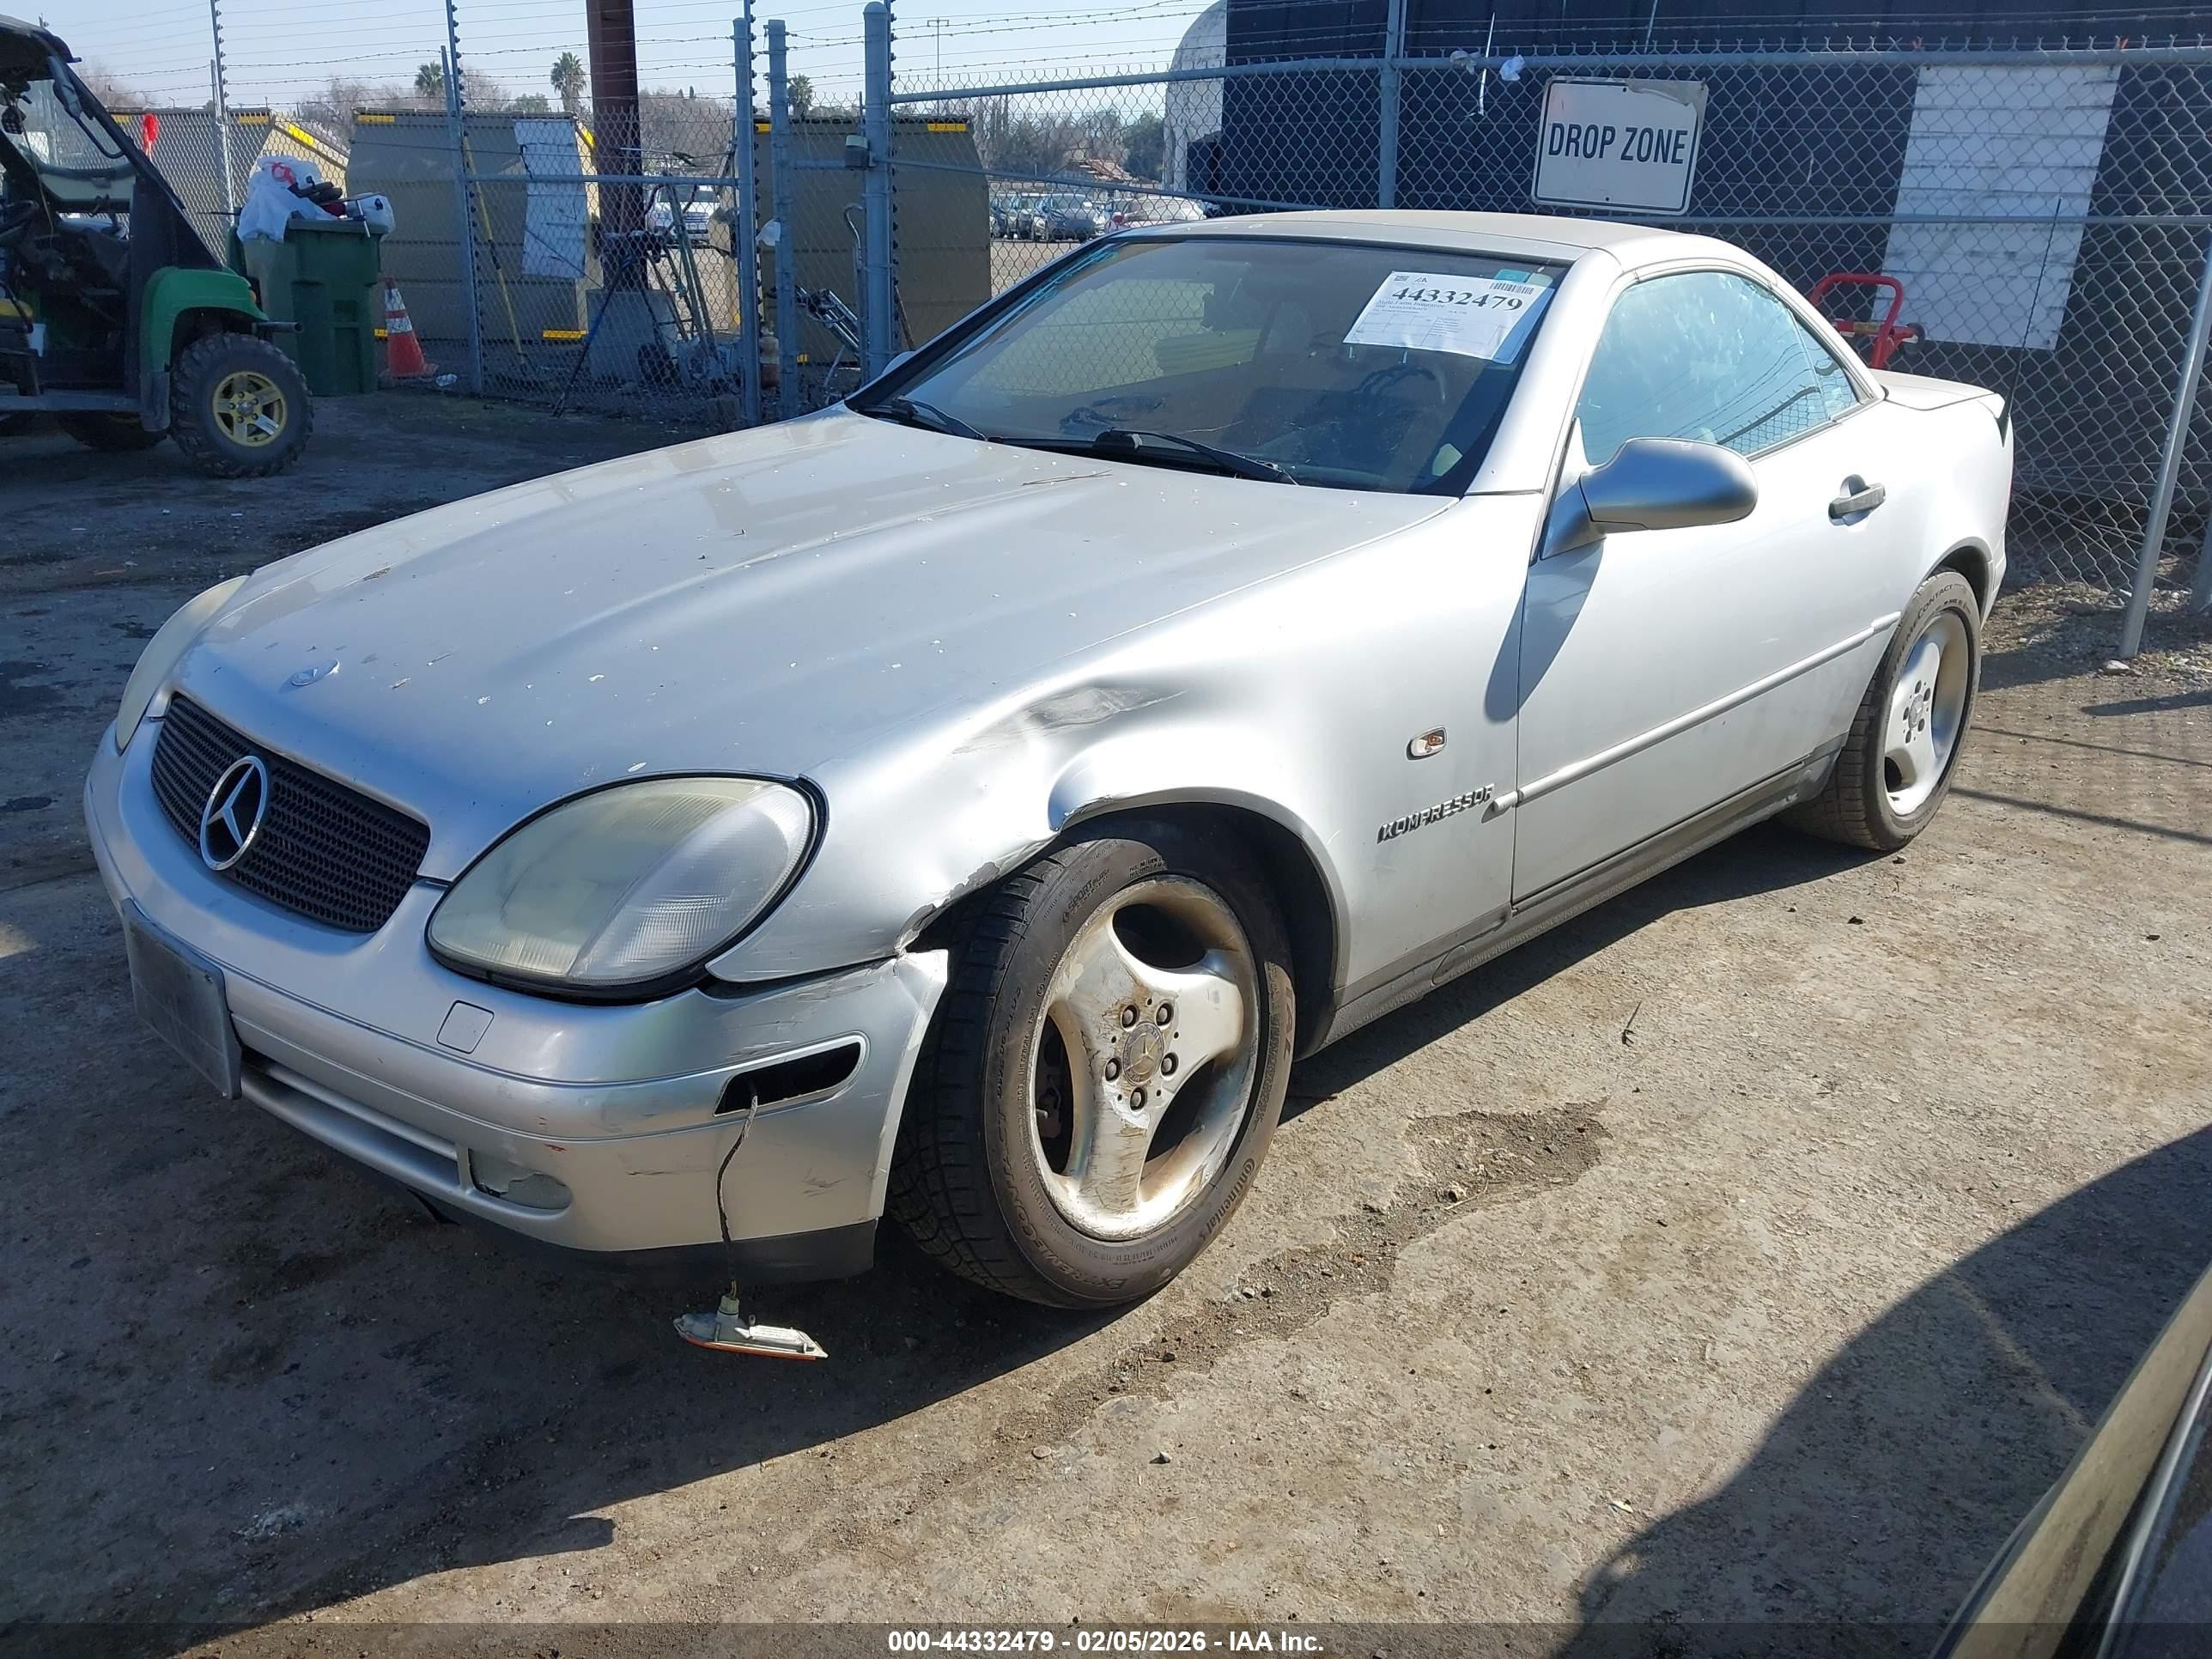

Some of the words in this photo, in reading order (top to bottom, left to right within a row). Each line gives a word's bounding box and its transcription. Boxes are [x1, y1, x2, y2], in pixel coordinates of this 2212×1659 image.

[1548, 122, 1616, 159] DROP
[1620, 126, 1688, 165] ZONE
[1392, 287, 1522, 311] 44332479
[1376, 783, 1495, 844] KOMPRESSOR
